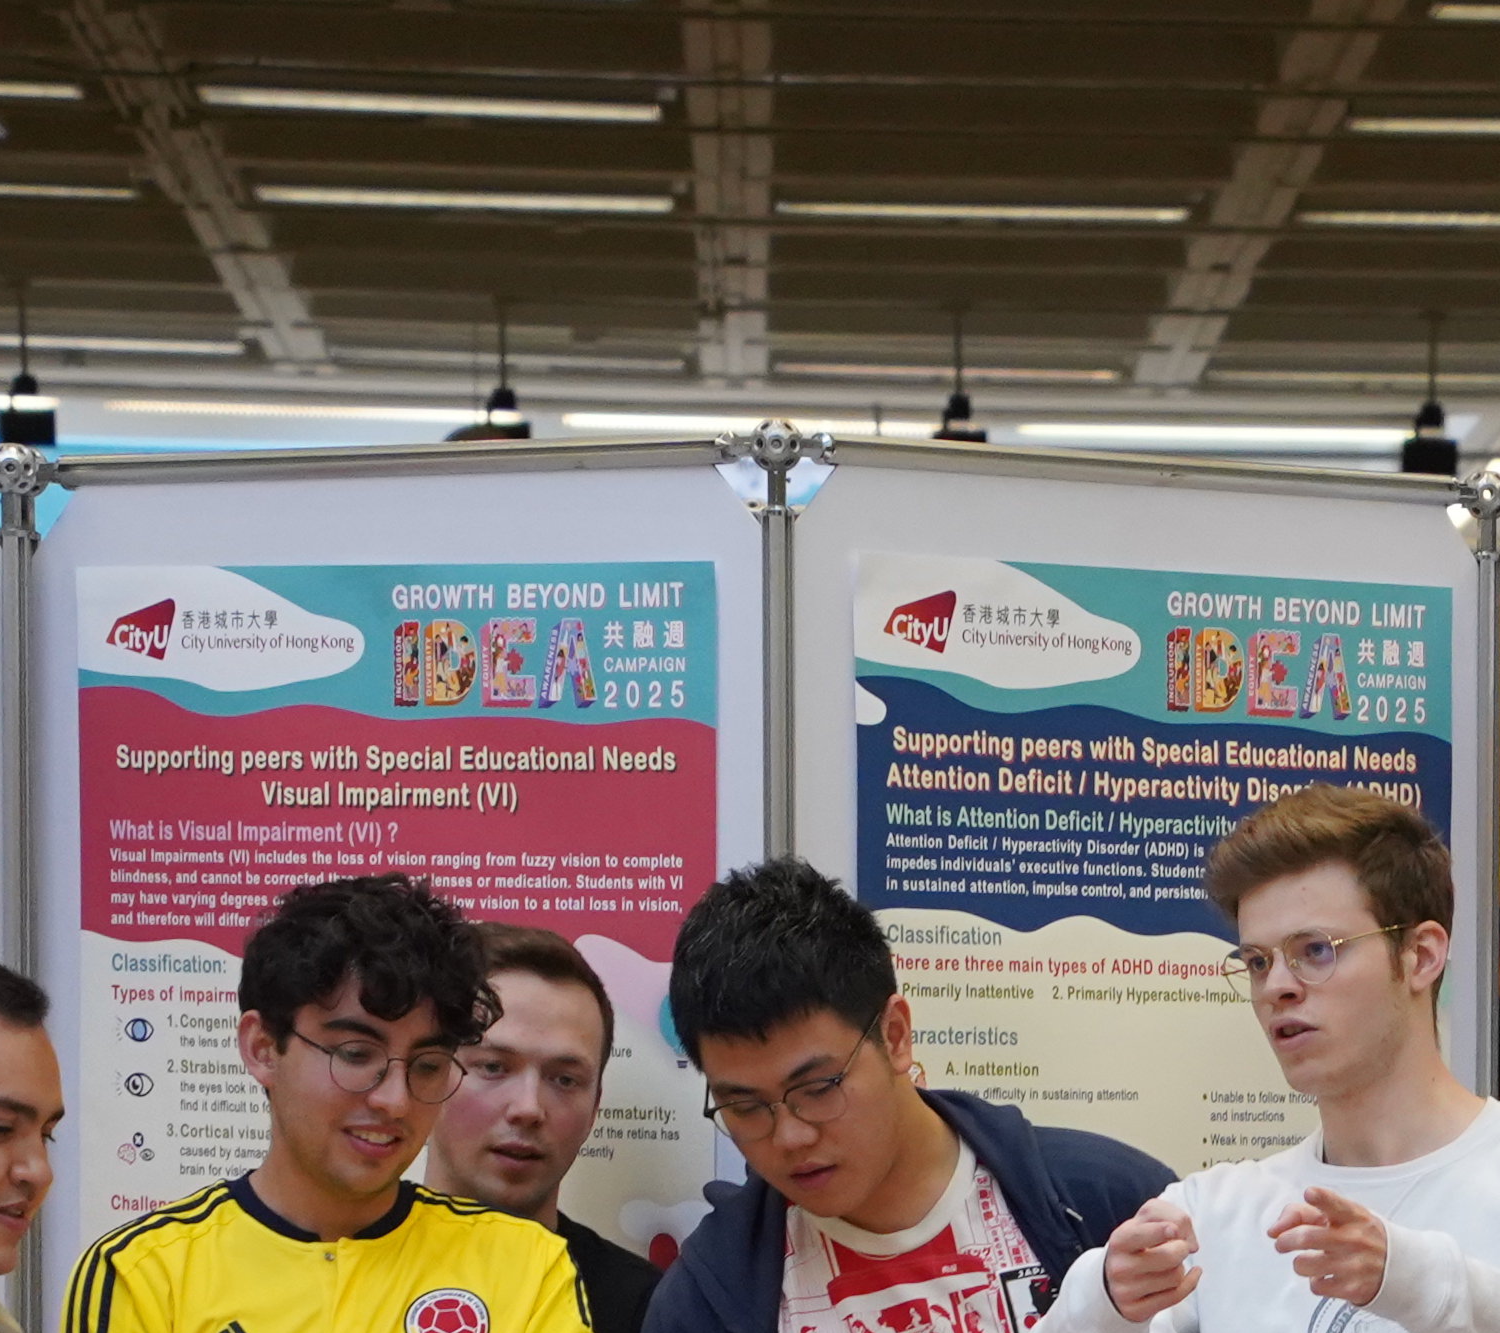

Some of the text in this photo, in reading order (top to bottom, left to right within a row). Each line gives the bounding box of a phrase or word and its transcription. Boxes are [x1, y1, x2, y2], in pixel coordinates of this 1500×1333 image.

[117, 745, 675, 774] Supporting peers with Special Educational Needs
[893, 727, 1416, 772] Supporting peers with Special Educational Needs
[262, 781, 516, 812] Visual Impairment (VI)
[887, 763, 990, 791] Attention
[999, 767, 1072, 794] Deficit
[1094, 772, 1240, 805] Hyperactivity
[887, 924, 1003, 946] Classification
